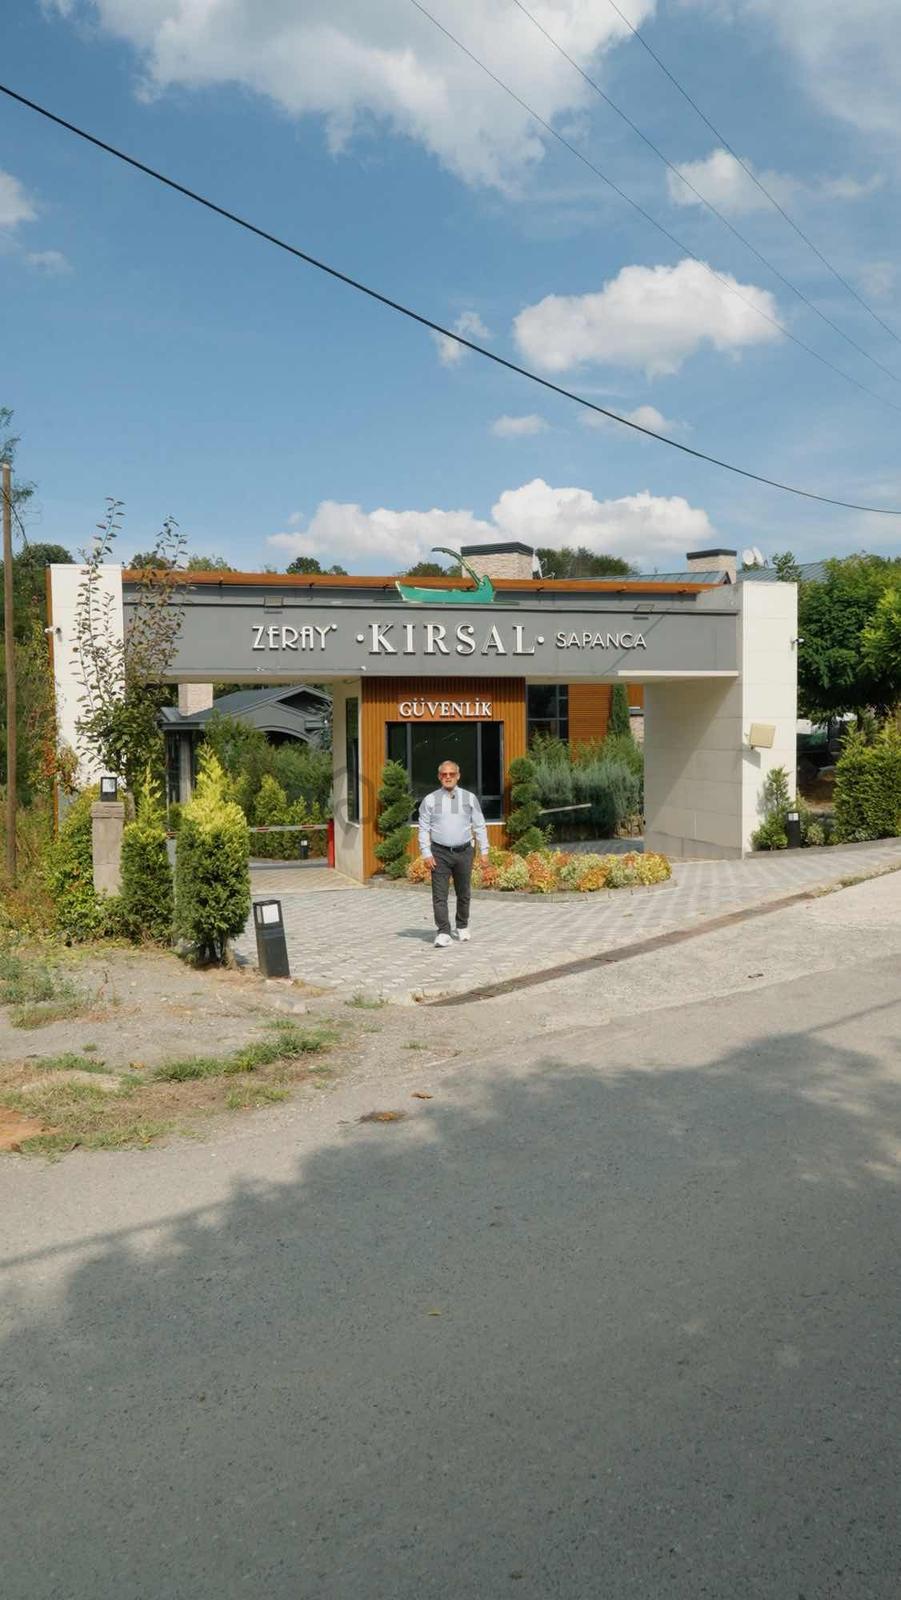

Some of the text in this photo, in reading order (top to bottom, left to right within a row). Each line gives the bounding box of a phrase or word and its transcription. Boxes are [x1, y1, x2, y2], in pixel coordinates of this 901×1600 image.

[252, 625, 337, 650] ZERAY
[556, 631, 648, 650] SAPANCA
[399, 698, 492, 718] GÜVENLİK
